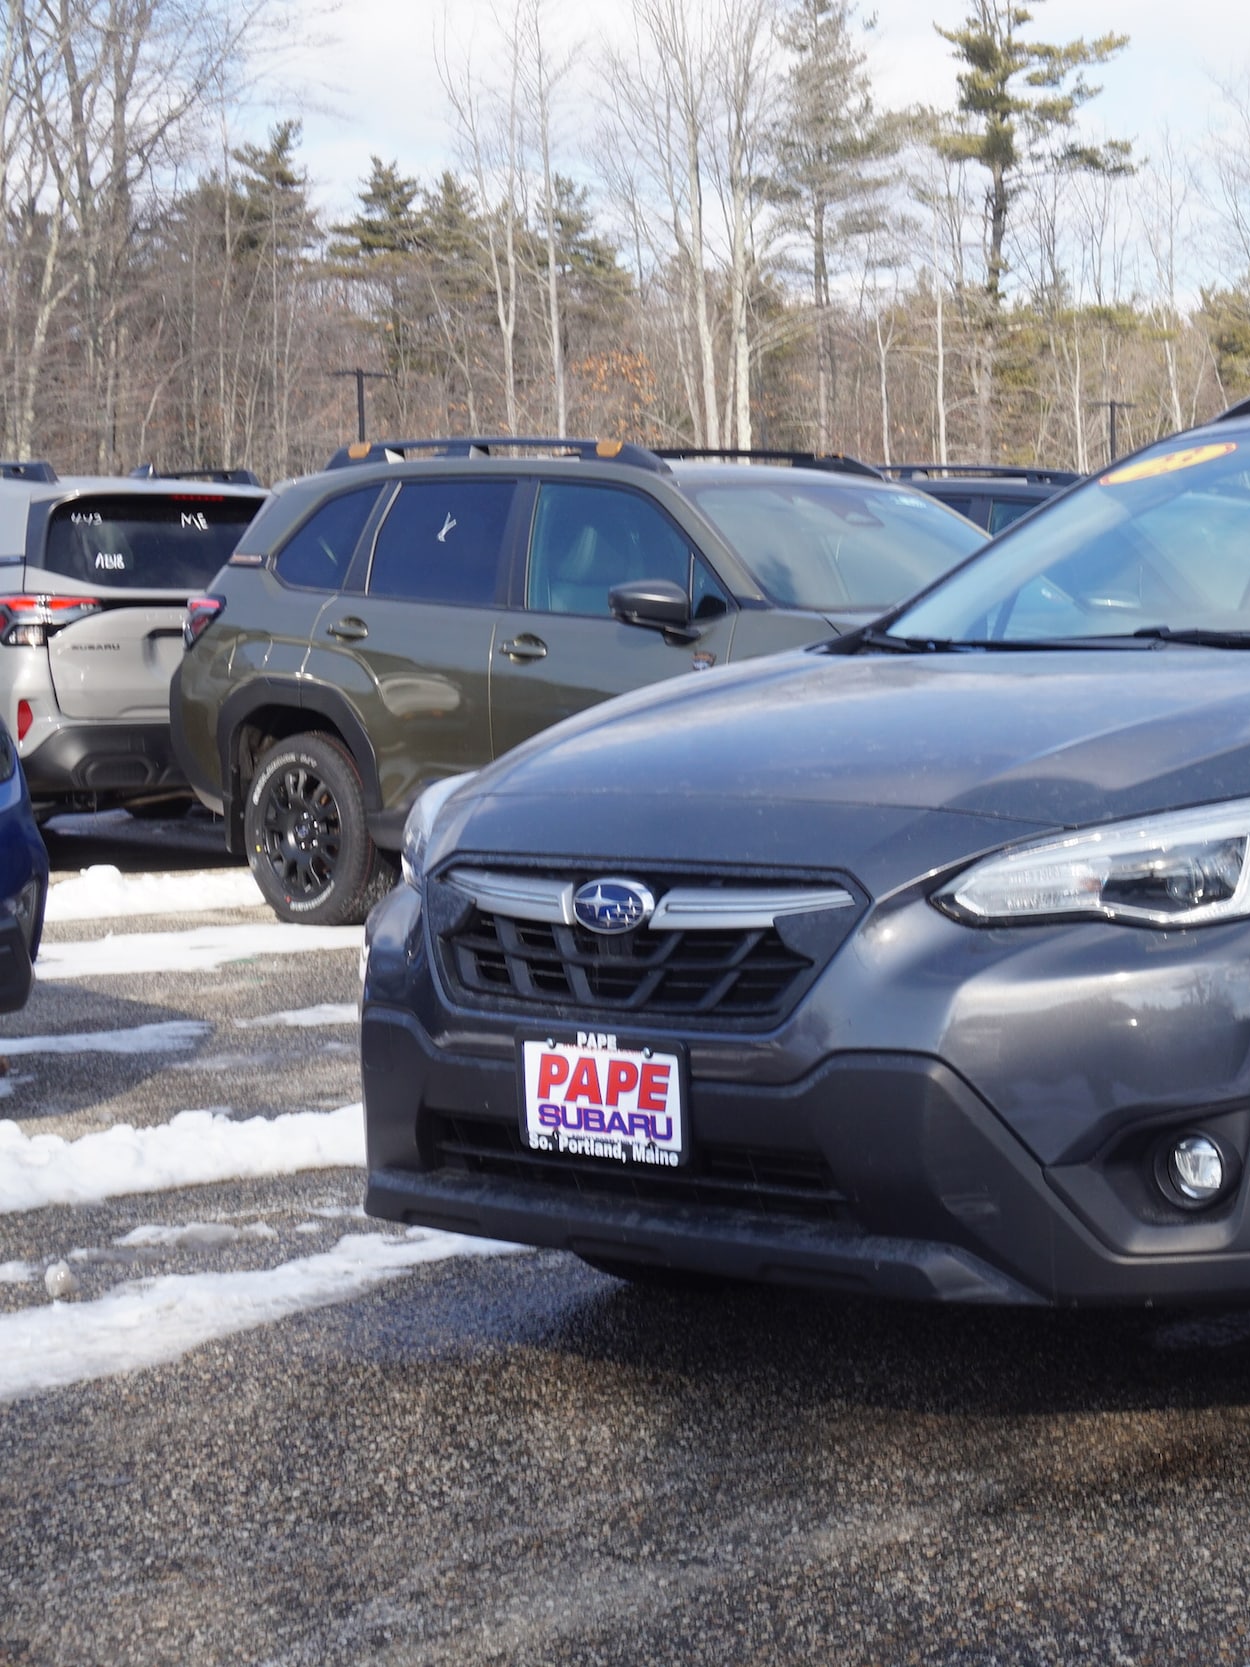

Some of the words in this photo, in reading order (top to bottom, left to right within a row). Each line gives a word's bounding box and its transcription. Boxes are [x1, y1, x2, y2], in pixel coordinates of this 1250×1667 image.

[72, 643, 120, 651] SUBARU
[576, 1031, 617, 1050] PAPE
[537, 1053, 671, 1112] PAPE
[538, 1103, 673, 1141] SUBARU
[528, 1131, 553, 1151] So.
[558, 1133, 627, 1164] Portland,
[632, 1143, 679, 1167] Maine
